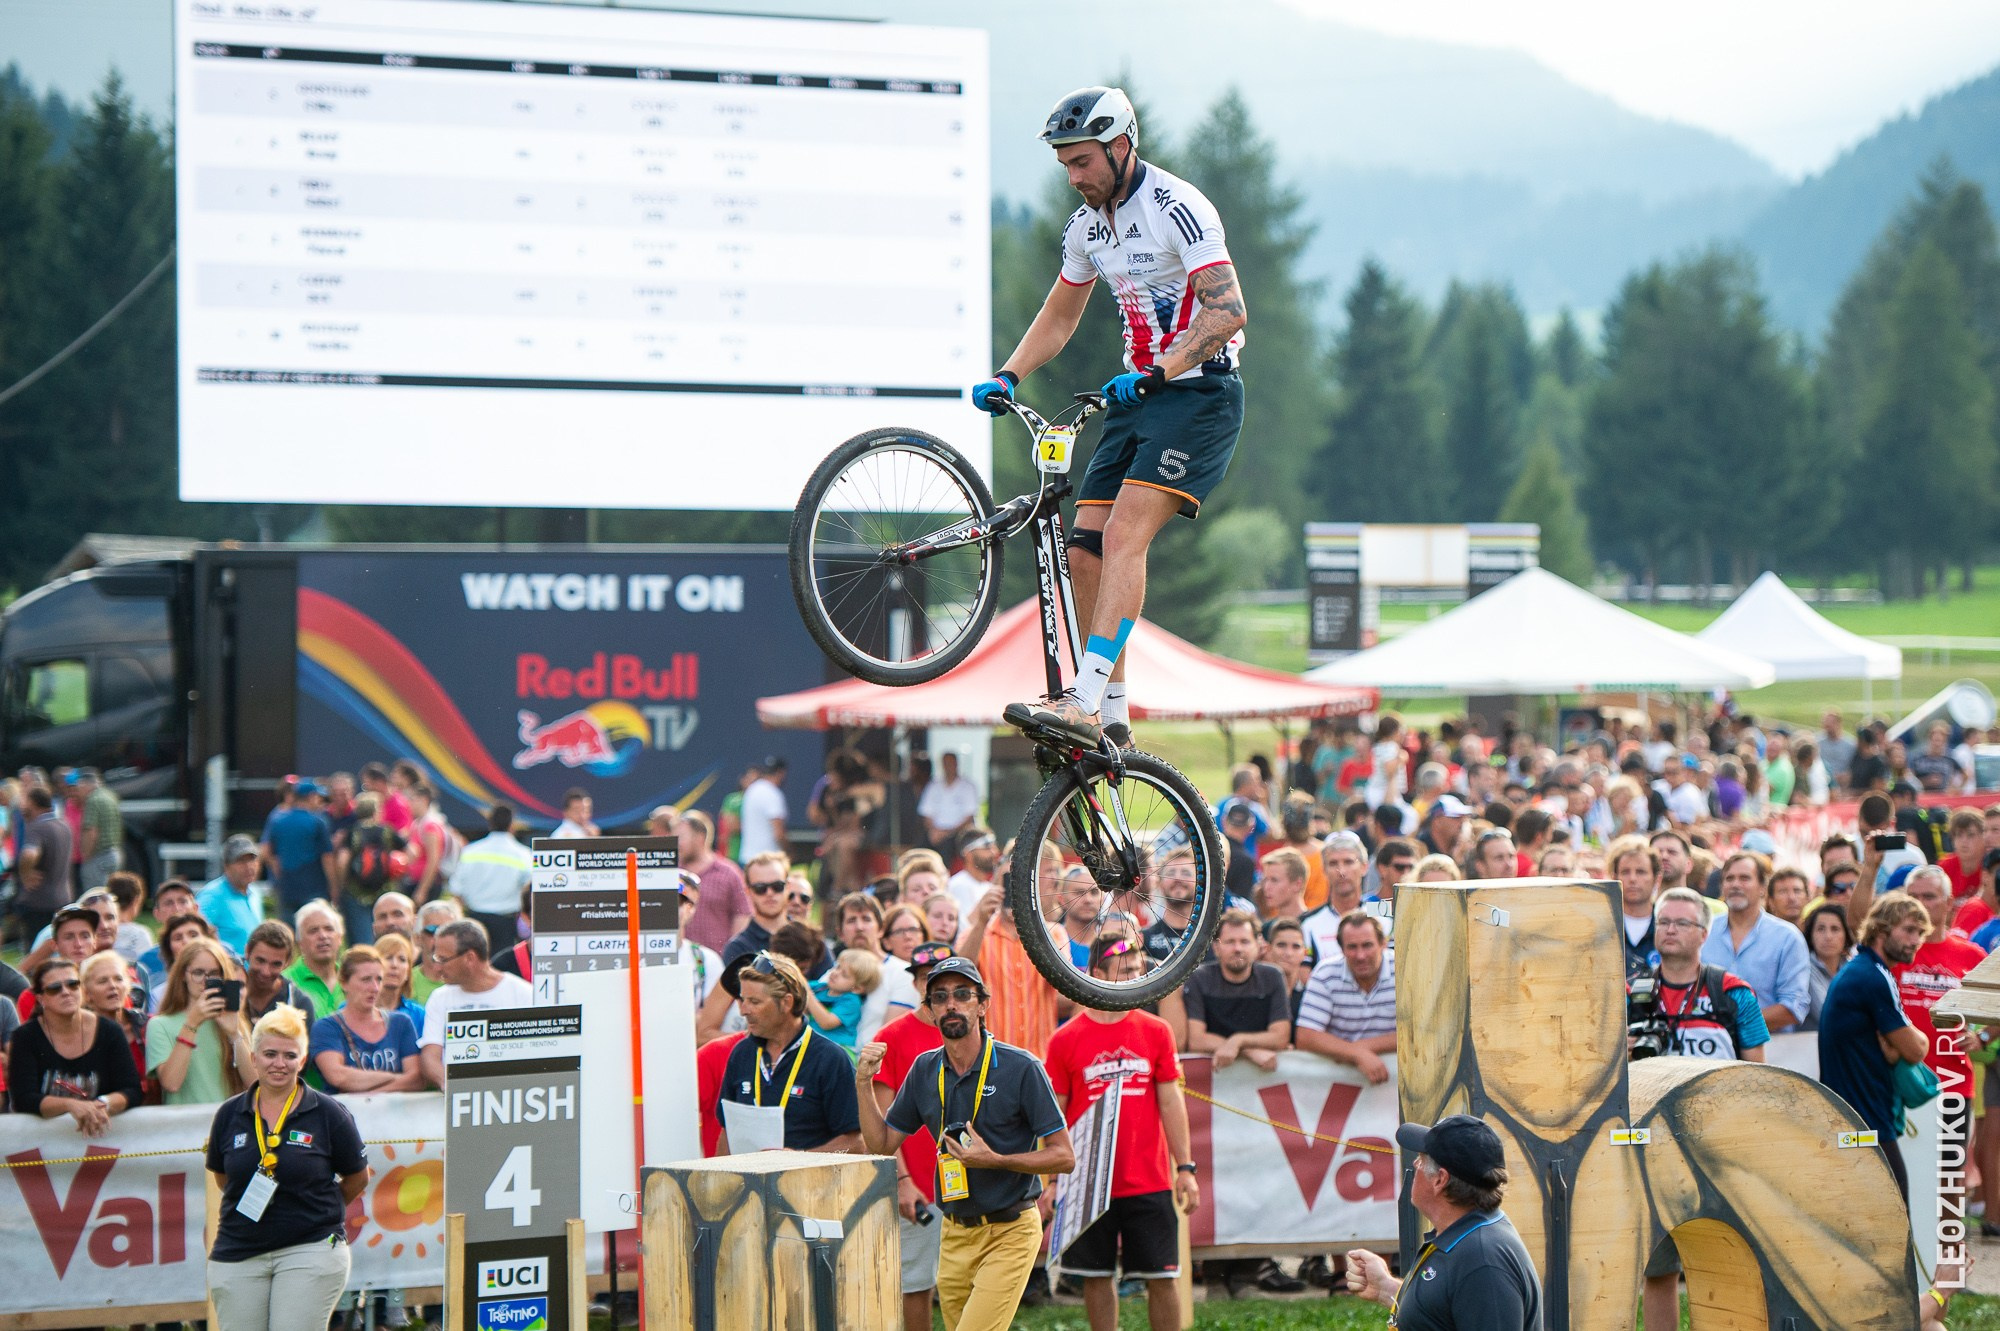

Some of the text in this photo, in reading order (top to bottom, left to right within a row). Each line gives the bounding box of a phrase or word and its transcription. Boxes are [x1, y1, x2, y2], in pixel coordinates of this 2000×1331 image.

[1154, 187, 1176, 212] sky
[1087, 220, 1112, 245] sky
[1048, 443, 1056, 461] 2
[1157, 448, 1190, 481] 5
[1052, 517, 1070, 580] JEALOUSY
[461, 572, 744, 612] WATCH IT ON
[516, 651, 699, 699] Red Bull
[642, 705, 699, 750] TV
[540, 854, 572, 867] UCI
[577, 860, 604, 868] WORLD
[603, 859, 660, 867] CHAMNSHIPS
[593, 852, 628, 860] MOUNTAI
[652, 851, 676, 859] TRIALS
[550, 941, 558, 952] 2
[649, 939, 671, 949] GBR
[537, 961, 552, 972] HC
[565, 960, 572, 971] 1
[588, 960, 597, 971] 2
[614, 958, 622, 970] 3
[454, 1024, 484, 1039] UCI
[489, 1022, 502, 1030] 2016
[503, 1020, 538, 1029] MOUNTAIN
[538, 1019, 552, 1027] BIKE
[558, 1017, 579, 1026] TRIALS
[489, 1026, 565, 1038] WORLD CHAMPIONSHIPS
[529, 1039, 558, 1048] TRENTINO
[451, 1084, 575, 1128] FINISH
[1257, 1082, 1396, 1213] Va
[484, 1145, 542, 1227] 4
[6, 1145, 187, 1282] Val
[496, 1265, 539, 1288] UCI
[487, 1305, 539, 1324] TRENTINO
